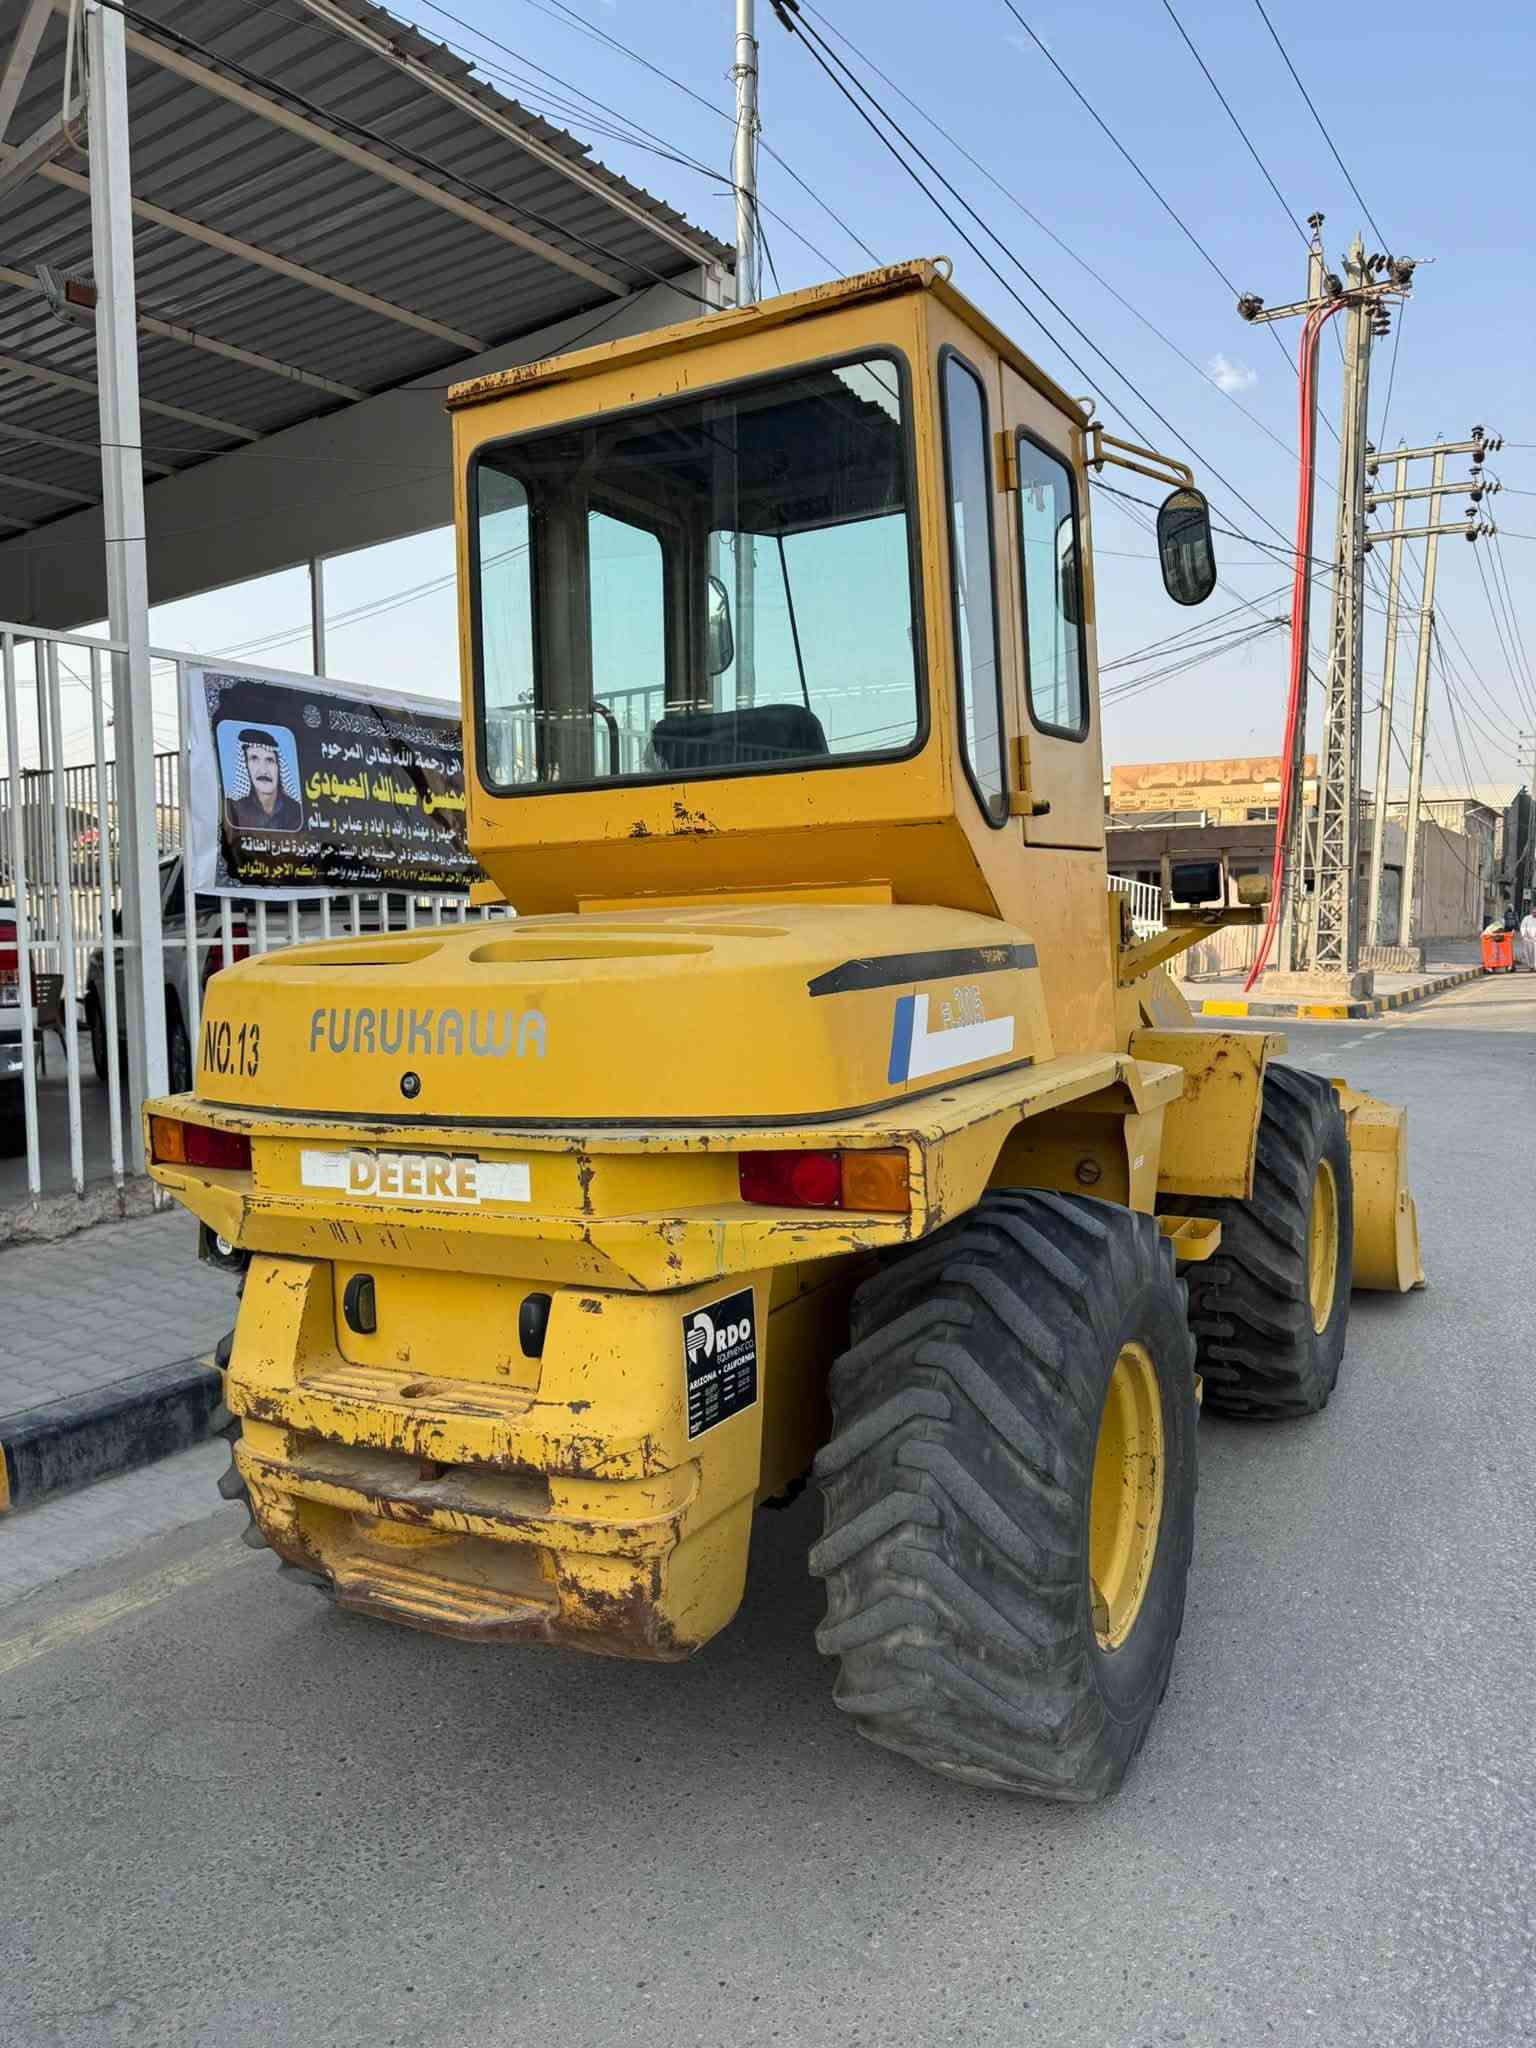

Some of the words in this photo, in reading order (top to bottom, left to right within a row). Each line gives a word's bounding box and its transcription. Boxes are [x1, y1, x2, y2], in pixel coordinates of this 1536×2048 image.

[321, 742, 363, 761] المرحوم
[365, 746, 393, 766] تعالى
[415, 751, 446, 775] رحمة
[305, 770, 369, 808] العبودي
[307, 811, 330, 830] سالم
[339, 816, 363, 836] عباس
[241, 836, 271, 853] الطاقة
[271, 839, 291, 856] شارع
[292, 839, 321, 857] الجزيرة
[371, 845, 397, 863] حسينية
[238, 860, 269, 879] والثواب
[271, 863, 294, 879] الاجر
[309, 1007, 546, 1060] FURUKAWA
[346, 1149, 480, 1203] DEERE
[715, 1318, 751, 1353] RDO
[689, 1370, 717, 1392] ARIZONA
[723, 1351, 755, 1373] CALIFORNIA
